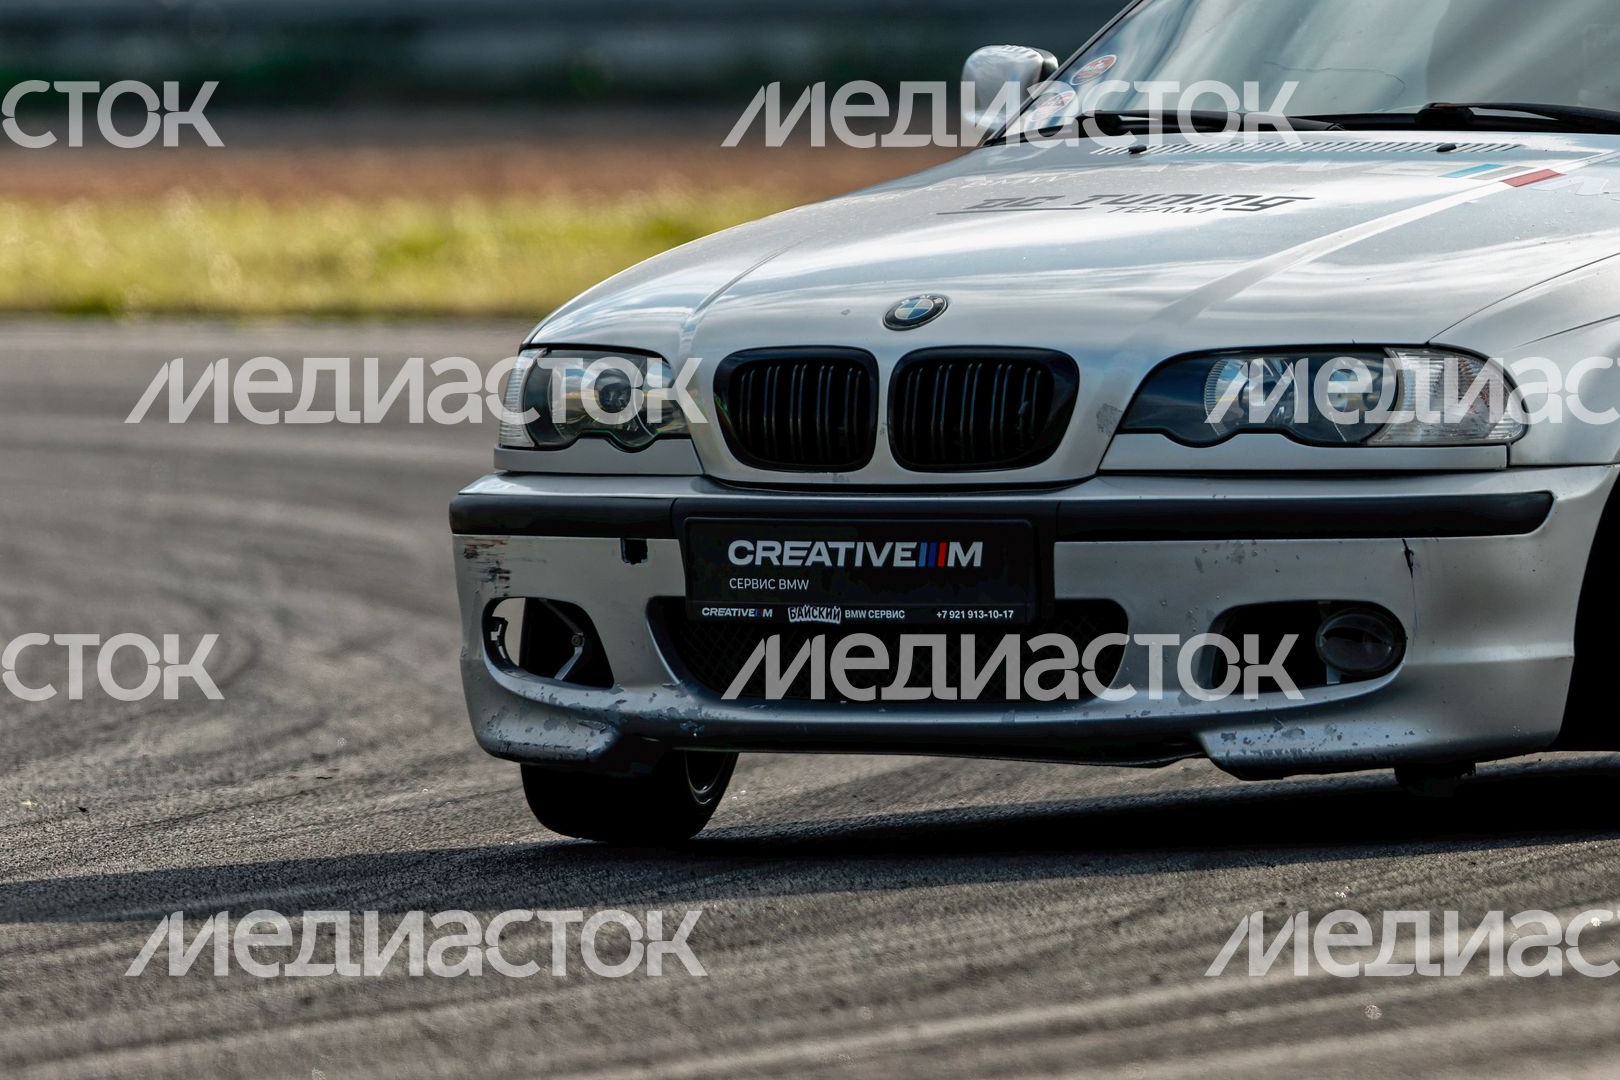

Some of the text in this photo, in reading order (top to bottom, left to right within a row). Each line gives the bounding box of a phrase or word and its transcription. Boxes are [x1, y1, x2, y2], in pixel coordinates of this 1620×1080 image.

[727, 539, 917, 567] CREATIVE
[729, 578, 809, 590] СЕРВИС BMW
[702, 607, 756, 617] CREATIVE
[788, 604, 905, 624] БАЙСКИЙ BMW СЕРВИС
[936, 610, 1014, 619] +7 921 913-10-17
